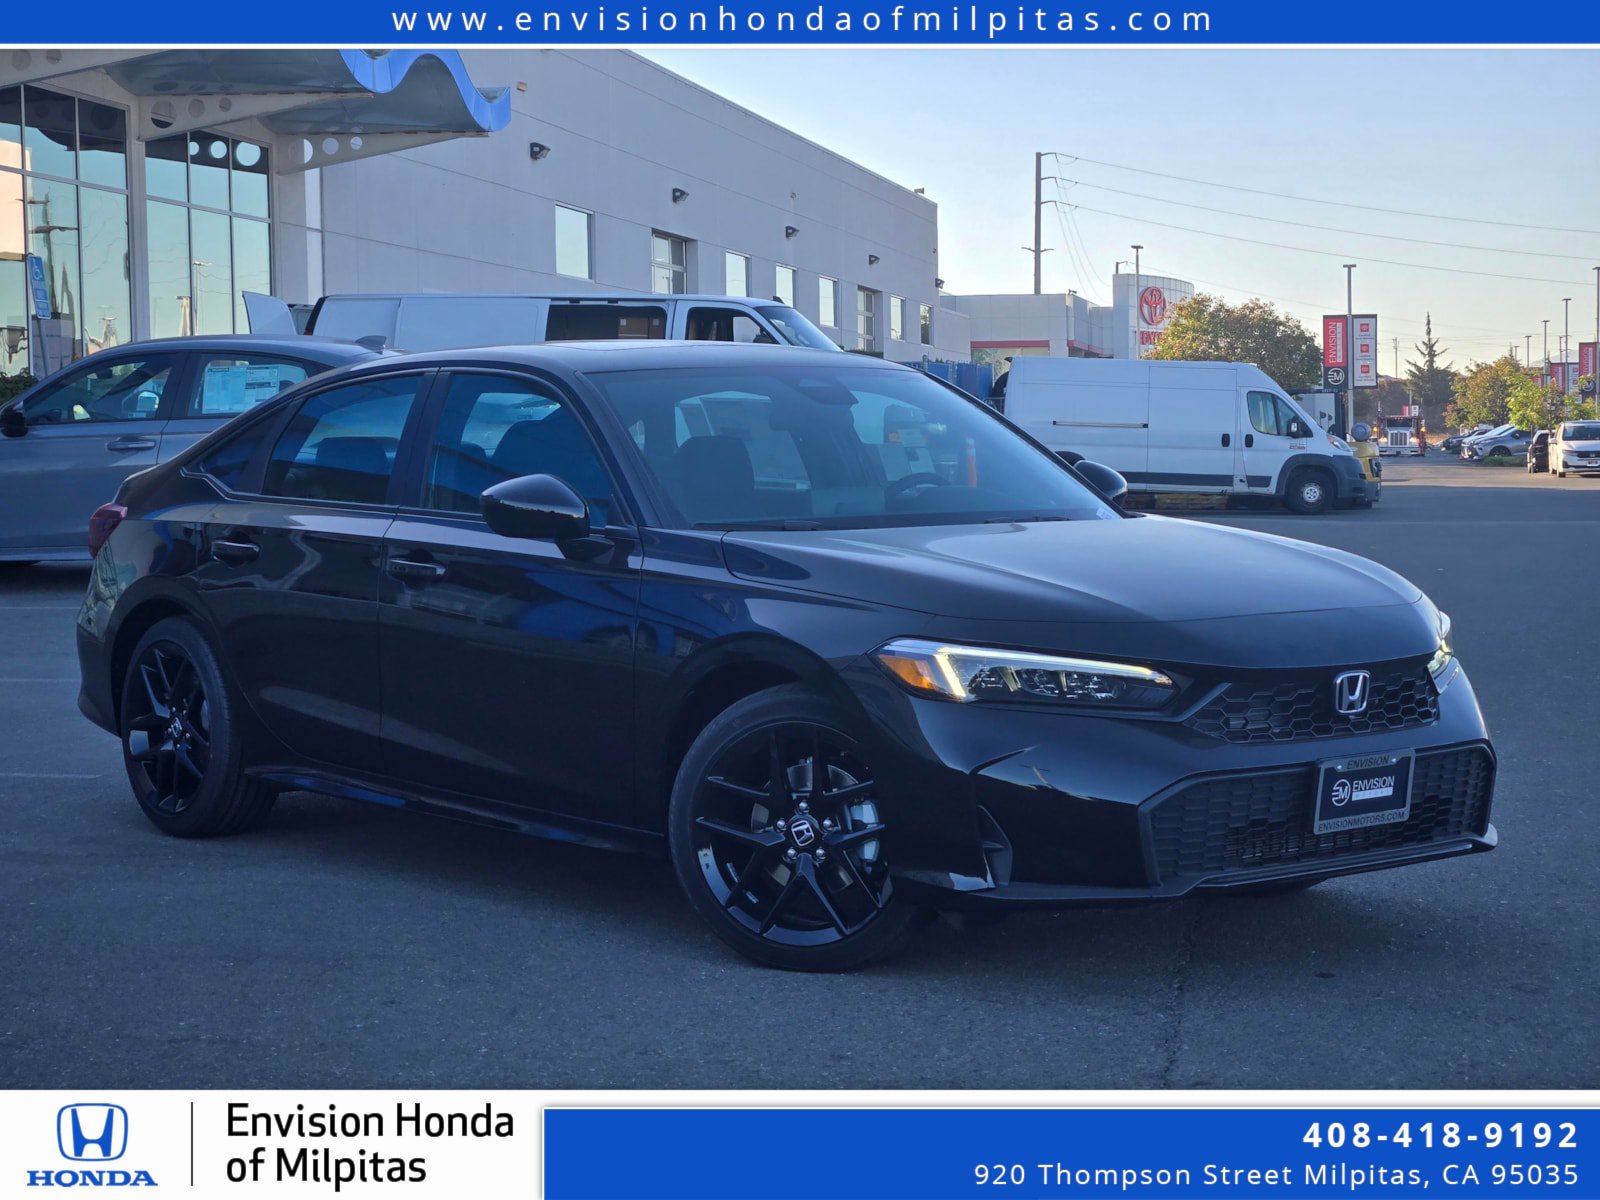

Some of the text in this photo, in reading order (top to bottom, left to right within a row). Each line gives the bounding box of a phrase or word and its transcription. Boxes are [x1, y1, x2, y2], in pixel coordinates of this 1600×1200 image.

[1328, 322, 1337, 363] ENVISION
[1347, 755, 1391, 770] ENVISION
[1352, 776, 1395, 792] ENVISION
[1319, 812, 1405, 831] ENVISIONMOTORS.COM
